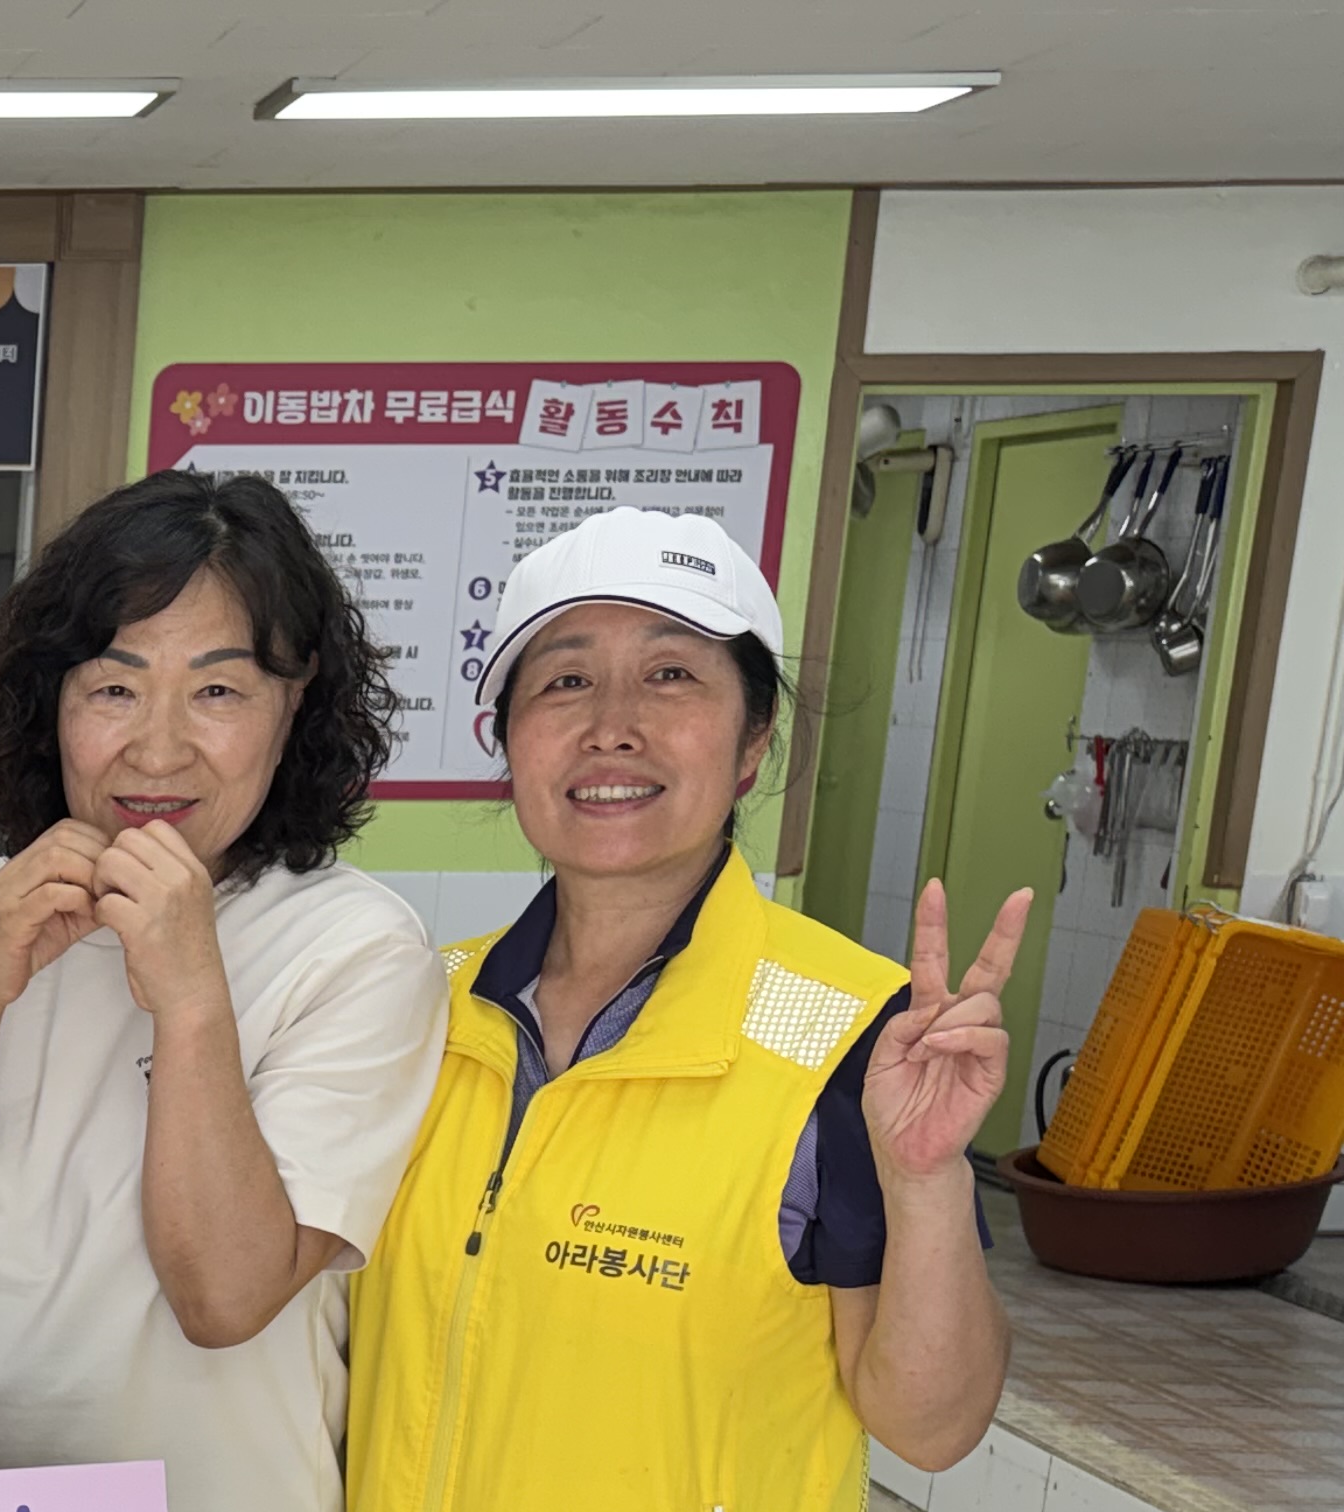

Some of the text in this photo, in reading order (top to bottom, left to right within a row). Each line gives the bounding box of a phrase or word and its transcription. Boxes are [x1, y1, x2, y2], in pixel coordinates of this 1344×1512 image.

[244, 391, 374, 425] 이동밥차
[385, 389, 515, 424] 무료급식
[484, 470, 496, 485] 5
[474, 580, 487, 598] 6
[471, 629, 483, 646] 7
[466, 661, 479, 678] 8
[584, 1220, 685, 1248] 안산시자원봉사센터
[545, 1239, 691, 1292] 아라봉사단
